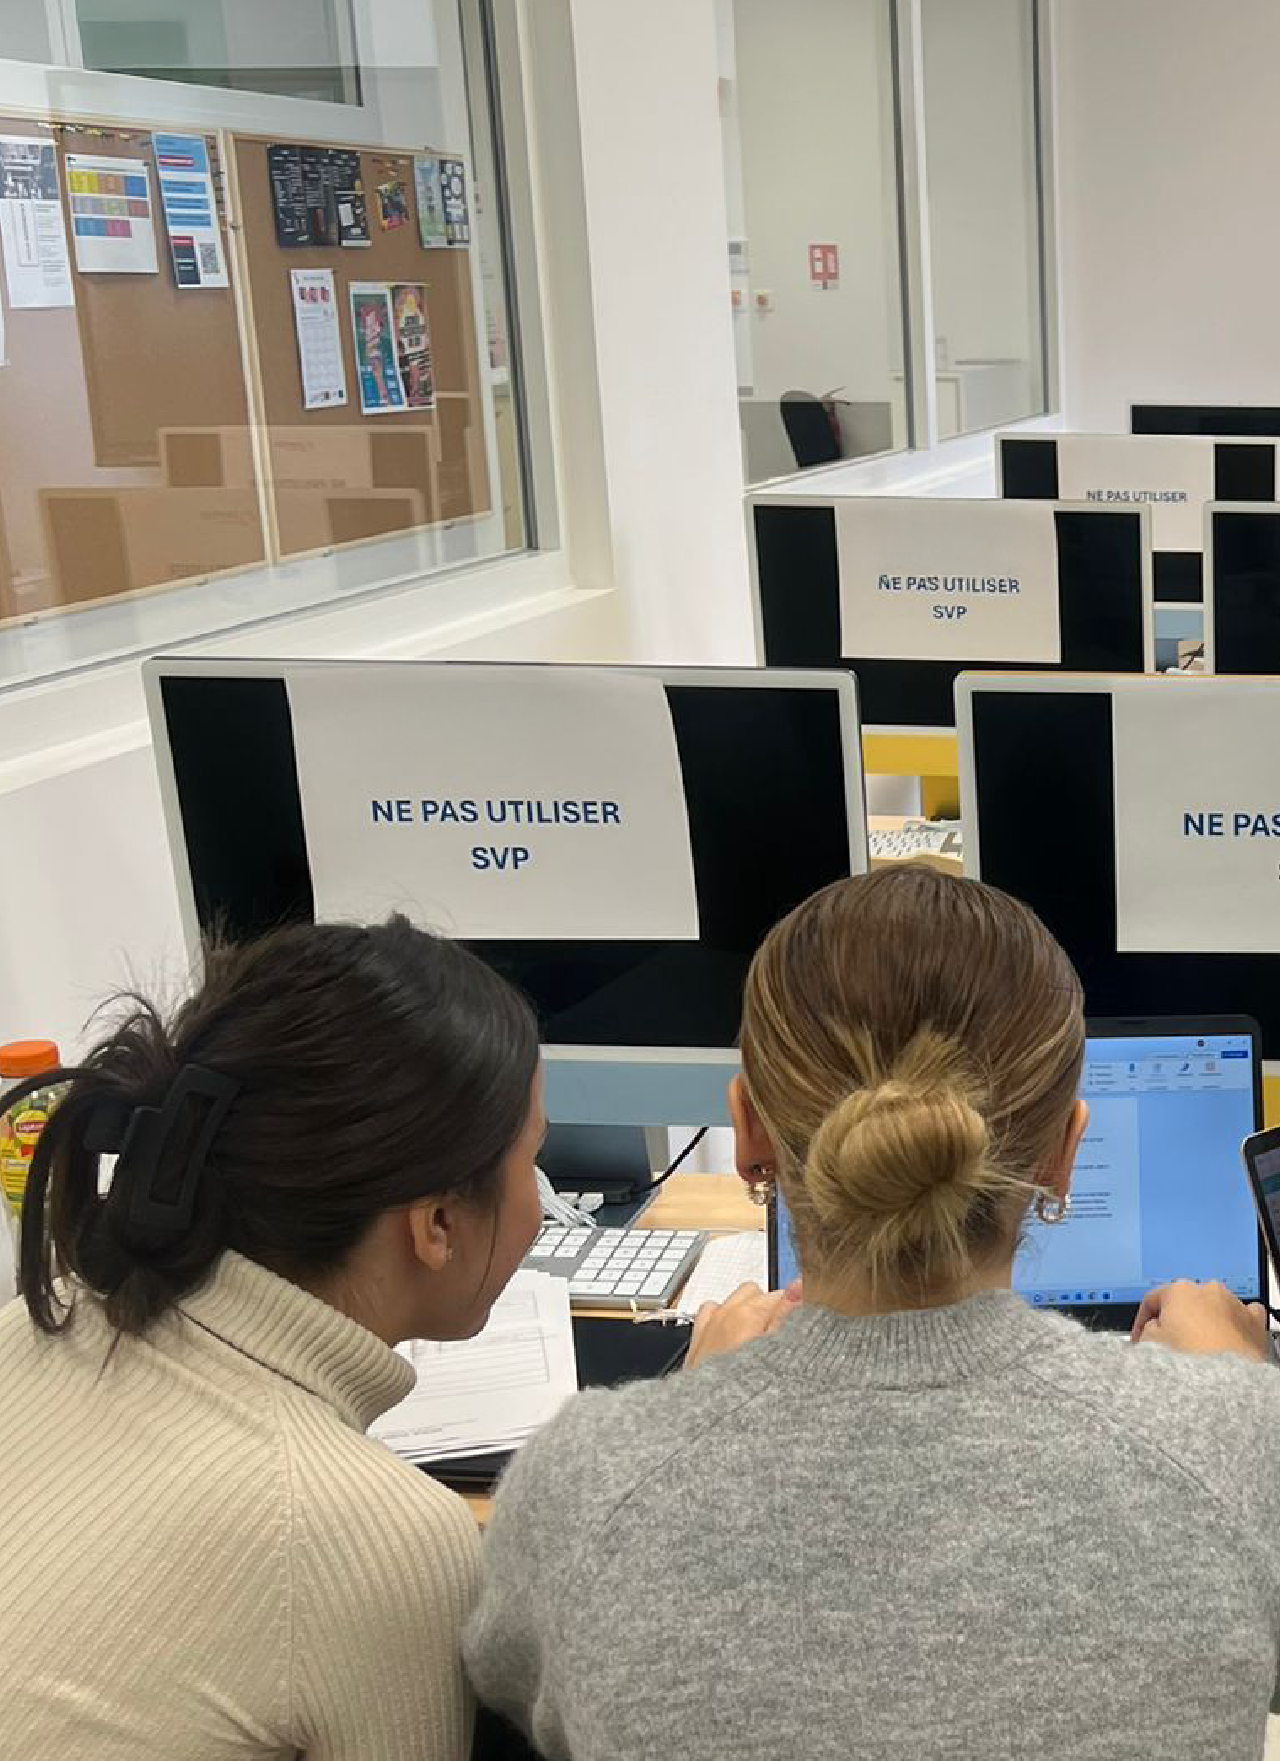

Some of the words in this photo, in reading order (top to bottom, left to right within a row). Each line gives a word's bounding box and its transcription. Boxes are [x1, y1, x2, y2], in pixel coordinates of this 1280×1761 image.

[878, 575, 902, 591] NE
[907, 576, 939, 591] PAS
[942, 576, 1020, 593] UTILISER
[932, 605, 968, 620] SVP
[371, 799, 415, 822] NE
[421, 799, 479, 824] PAS
[485, 800, 622, 824] UTILISER
[1183, 812, 1224, 836] NE
[470, 846, 529, 870] SVP
